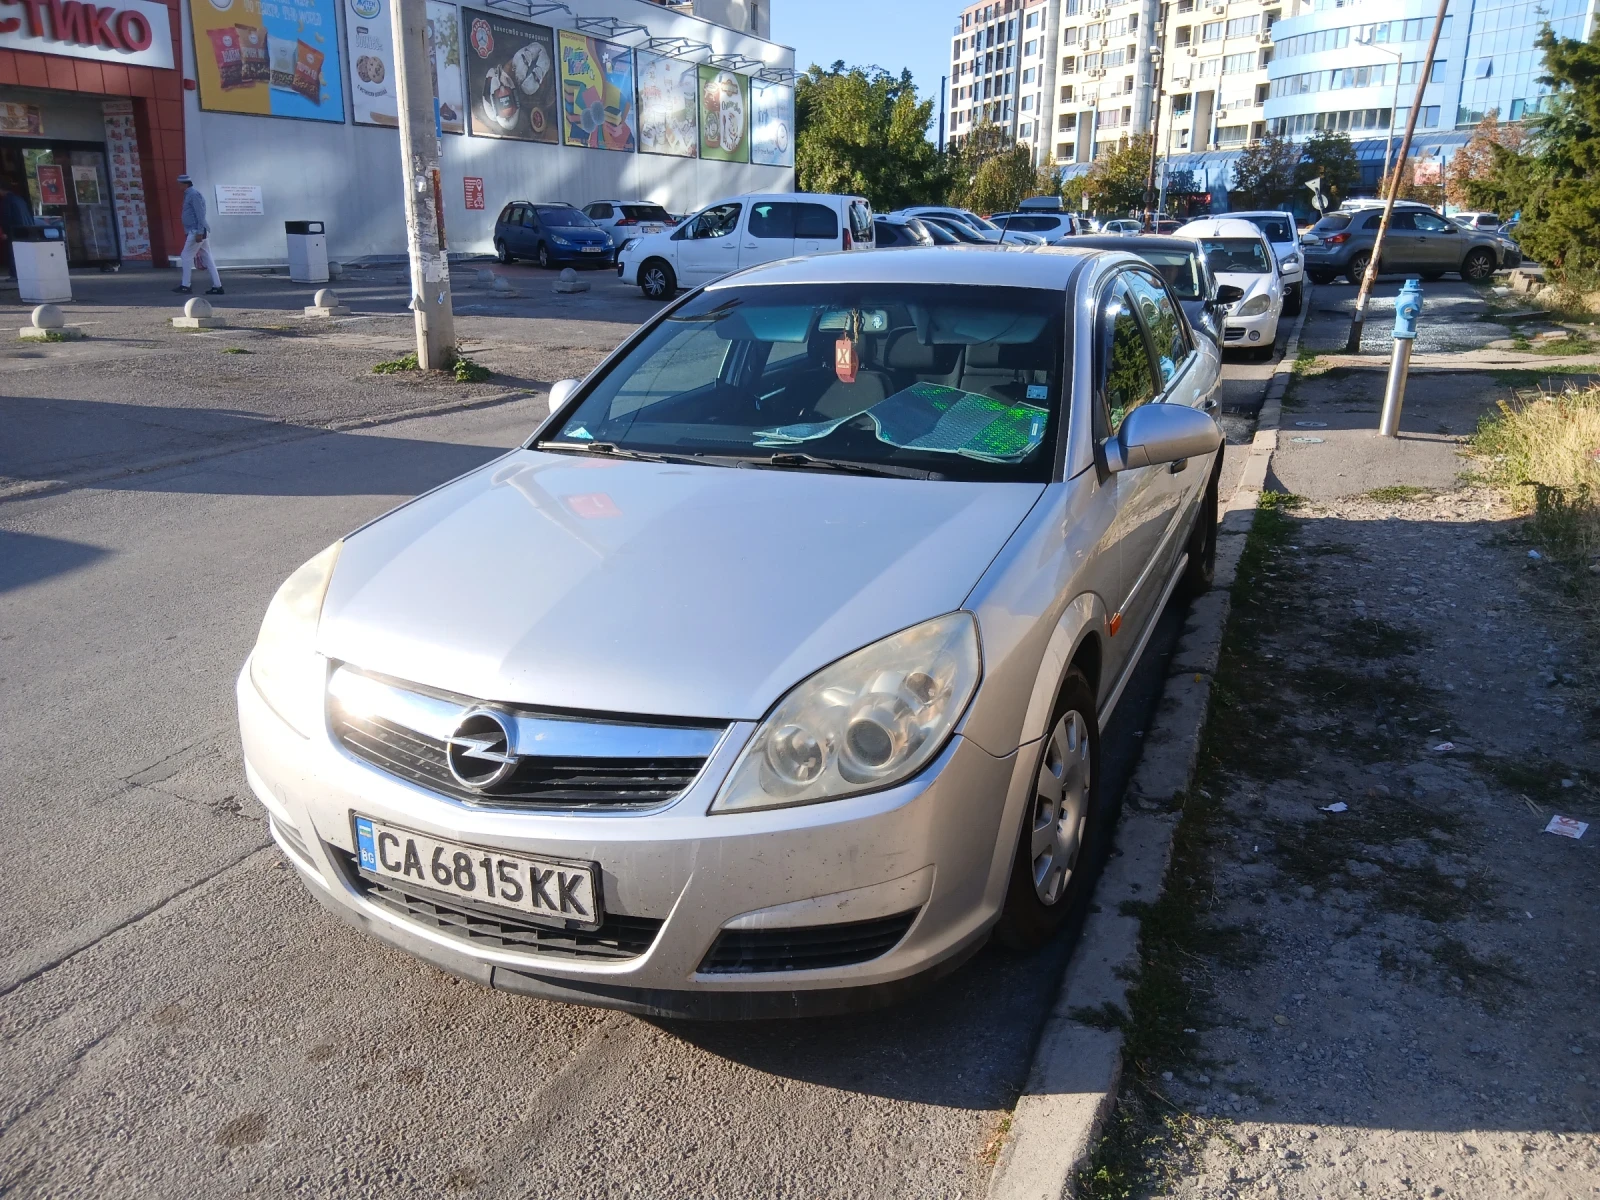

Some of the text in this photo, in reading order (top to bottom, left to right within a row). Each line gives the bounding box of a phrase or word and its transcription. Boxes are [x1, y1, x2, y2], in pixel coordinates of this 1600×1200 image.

[493, 24, 519, 36] качество
[524, 33, 549, 42] традиция
[361, 848, 375, 865] BG
